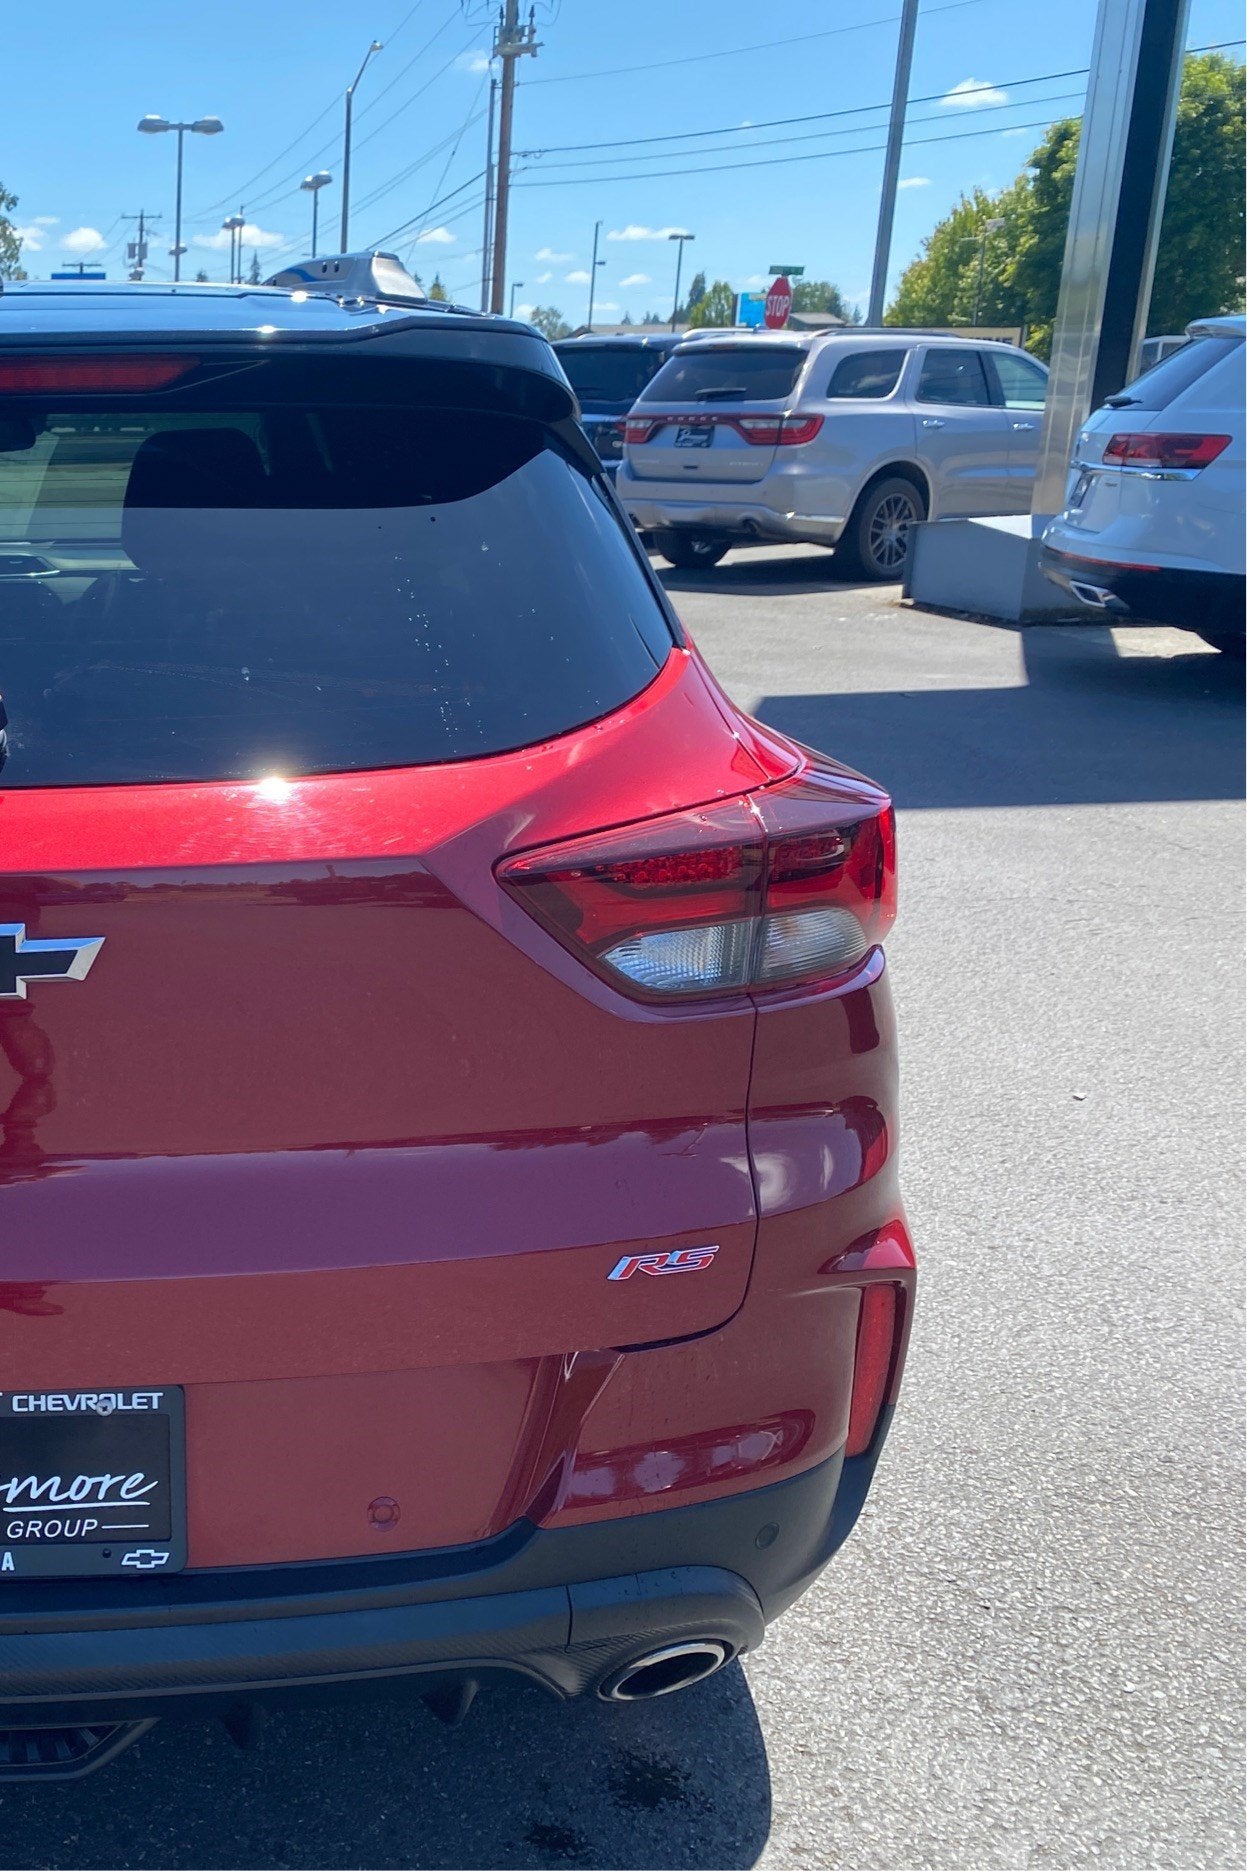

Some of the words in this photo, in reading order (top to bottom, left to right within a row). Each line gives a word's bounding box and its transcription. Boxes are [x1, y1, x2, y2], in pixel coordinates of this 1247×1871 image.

[766, 295, 790, 317] STOP
[607, 1245, 720, 1281] RS
[6, 1518, 99, 1540] GROUP
